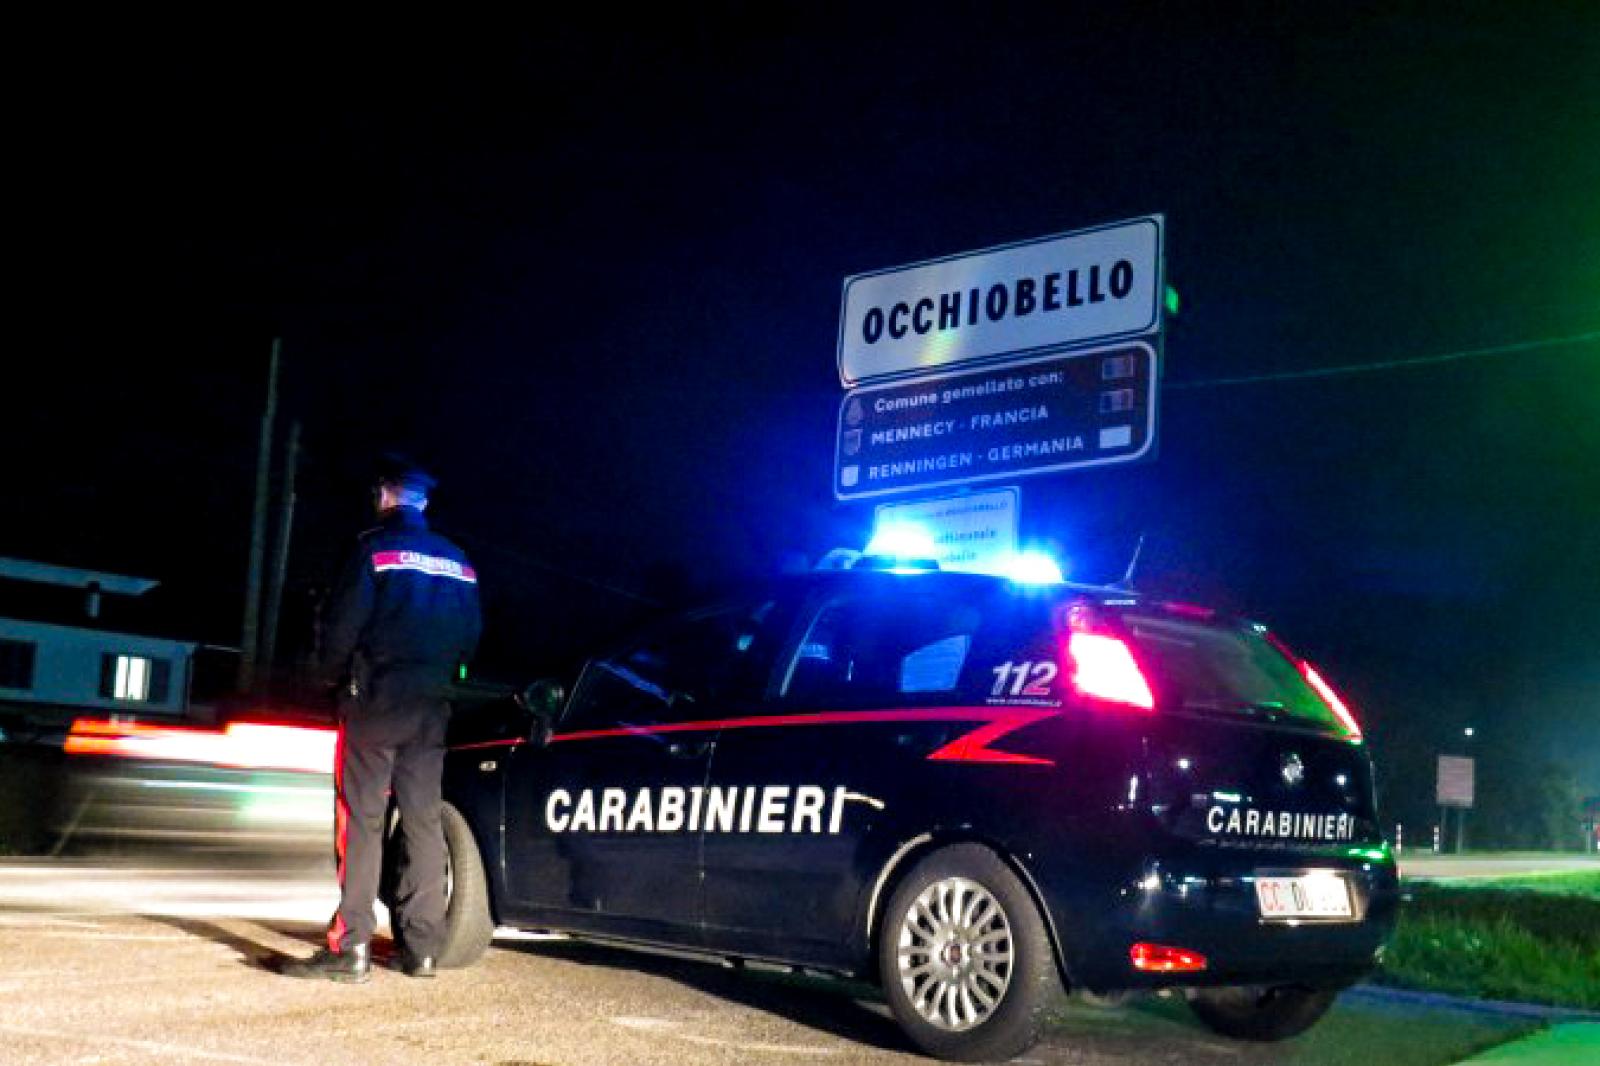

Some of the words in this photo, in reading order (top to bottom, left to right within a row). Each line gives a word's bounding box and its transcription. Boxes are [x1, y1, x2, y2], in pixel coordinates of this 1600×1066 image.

[862, 260, 1134, 345] OCCHIOBELLO
[874, 392, 937, 413] Comune
[942, 376, 1024, 403] gemellato
[870, 420, 956, 446] MENNECY
[971, 404, 1049, 430] FRANCIA
[869, 452, 973, 480] RENNINGEN
[987, 435, 1084, 462] GERMANIA
[991, 661, 1057, 695] 112
[545, 785, 847, 833] CARABINIERI
[1207, 805, 1356, 840] CARABINIERI
